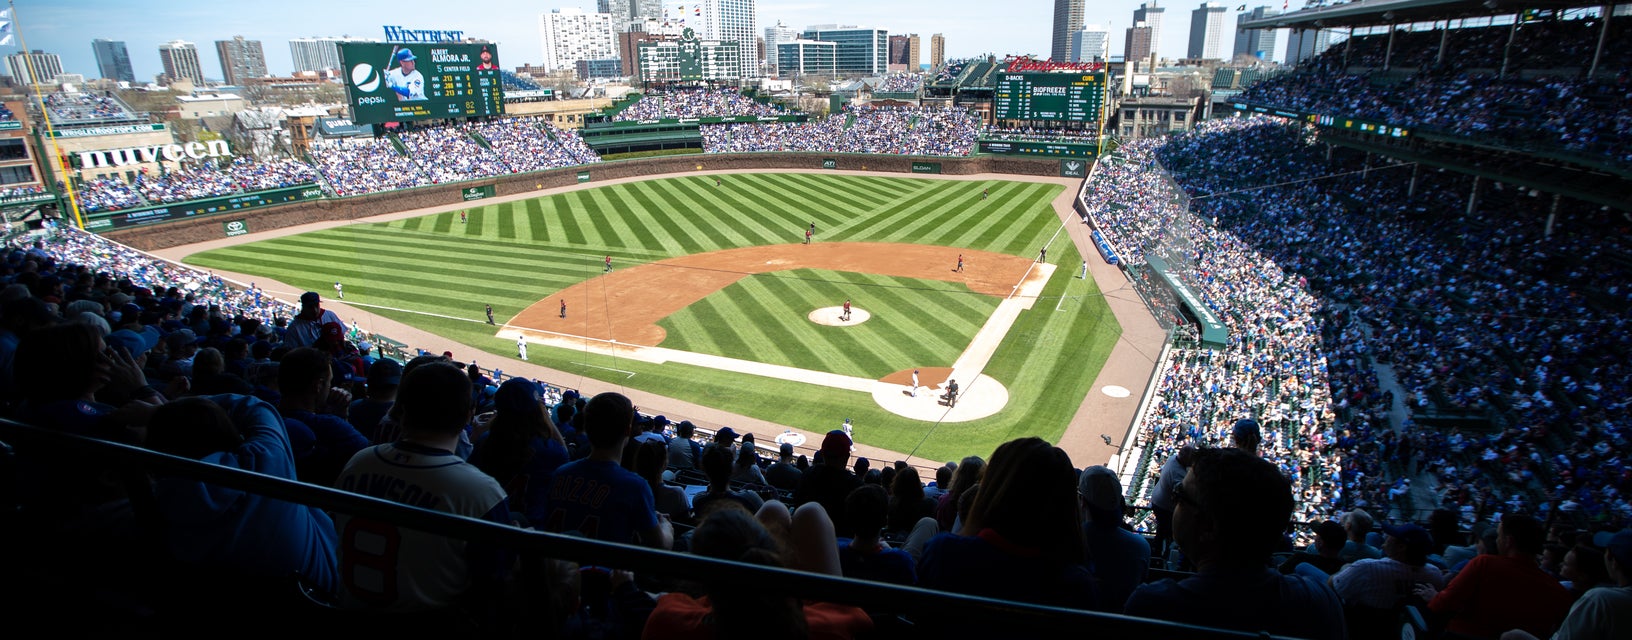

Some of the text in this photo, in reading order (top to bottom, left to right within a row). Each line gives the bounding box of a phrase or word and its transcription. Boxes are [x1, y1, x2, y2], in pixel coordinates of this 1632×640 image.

[383, 25, 463, 43] WINTRUST
[432, 54, 460, 62] ALMORA
[1004, 55, 1104, 72] Budweiser
[358, 96, 382, 106] pepsi
[465, 101, 475, 109] 82
[81, 140, 235, 169] nuveen
[342, 473, 441, 508] DAWSON
[550, 476, 610, 508] RIZZO
[343, 517, 400, 608] 8
